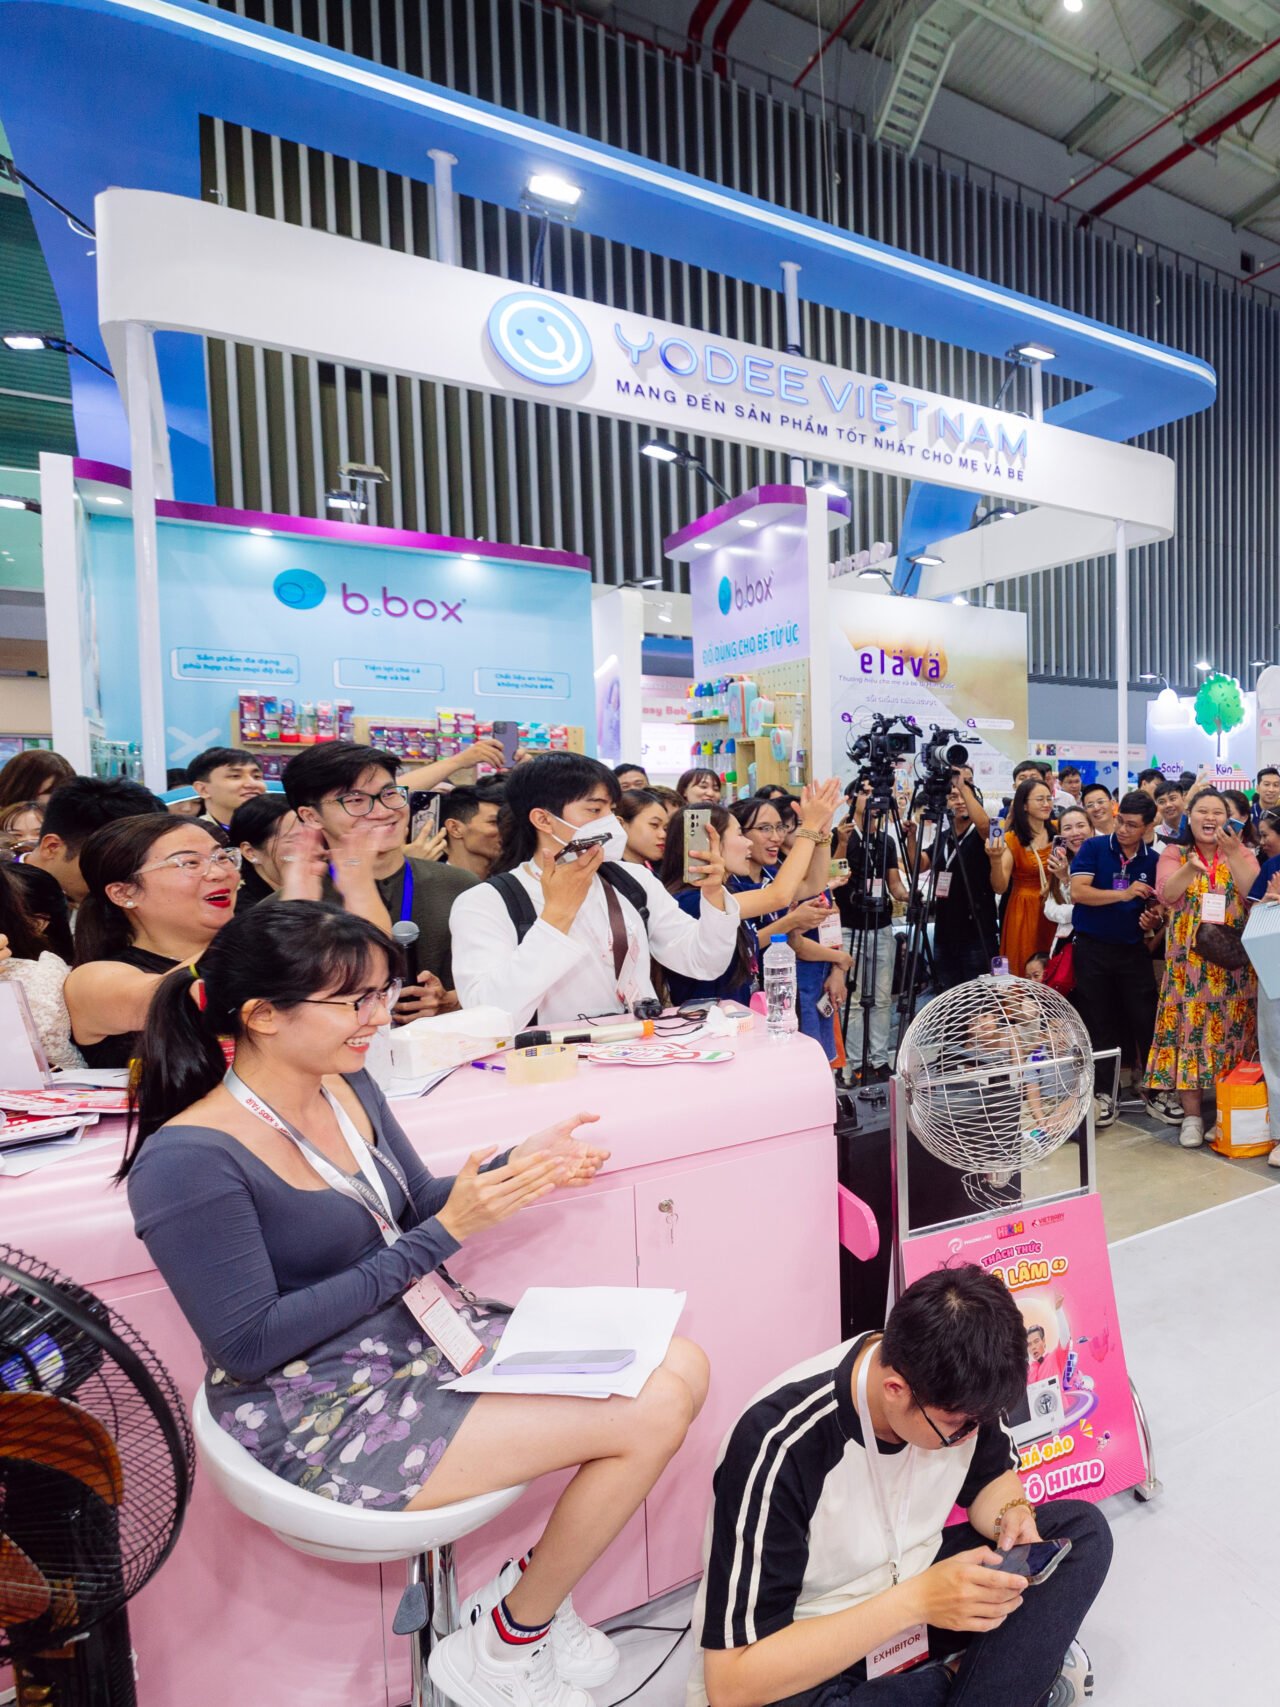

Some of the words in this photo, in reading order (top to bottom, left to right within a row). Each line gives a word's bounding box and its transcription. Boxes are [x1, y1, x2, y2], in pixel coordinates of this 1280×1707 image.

[614, 322, 809, 405] YODEE
[819, 375, 928, 432] VIỆT
[936, 406, 1028, 459] NAM
[616, 378, 677, 403] MANG
[686, 391, 726, 414] ĐẾN
[735, 403, 771, 424] SẢN
[780, 414, 828, 436] PHẨM
[836, 425, 868, 445] TỐT
[873, 436, 916, 456] NHẤT
[921, 449, 954, 465] CHO
[958, 456, 979, 472] MẸ
[738, 636, 755, 656] CHO
[860, 648, 941, 679] elävä
[997, 1221, 1024, 1239] Hikid
[981, 1248, 1015, 1267] THÁCH
[1015, 1240, 1041, 1255] THỨC
[1007, 1260, 1049, 1286] LÂM
[1021, 1445, 1041, 1468] HÁ
[1047, 1461, 1102, 1493] HIKID
[873, 1633, 921, 1664] EXHIBITOR
